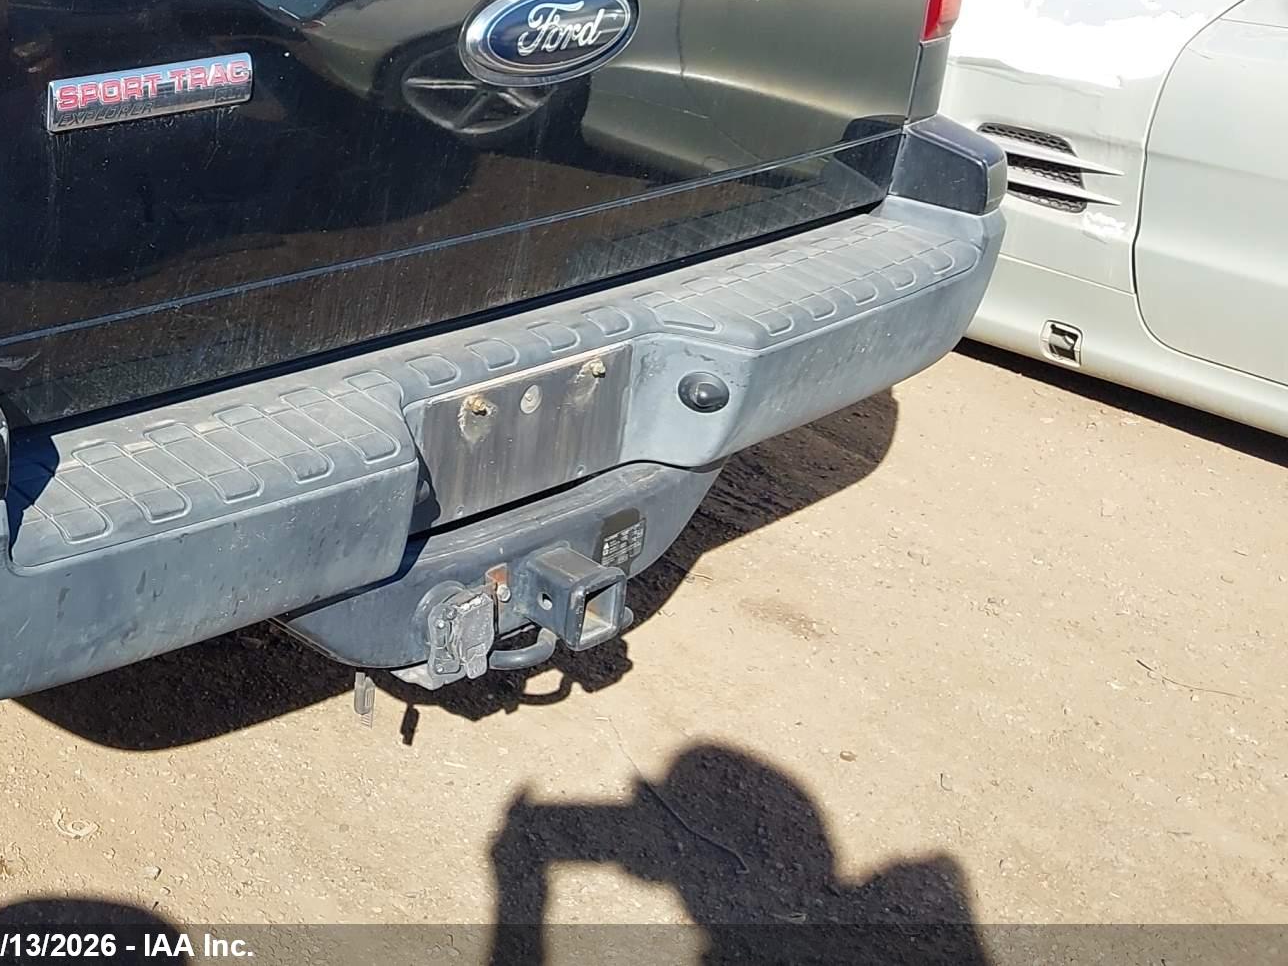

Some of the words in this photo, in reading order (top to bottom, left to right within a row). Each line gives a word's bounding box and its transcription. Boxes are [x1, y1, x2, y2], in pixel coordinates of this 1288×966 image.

[517, 0, 605, 56] Ford
[56, 74, 161, 111] SPORT
[168, 60, 250, 92] TRAC
